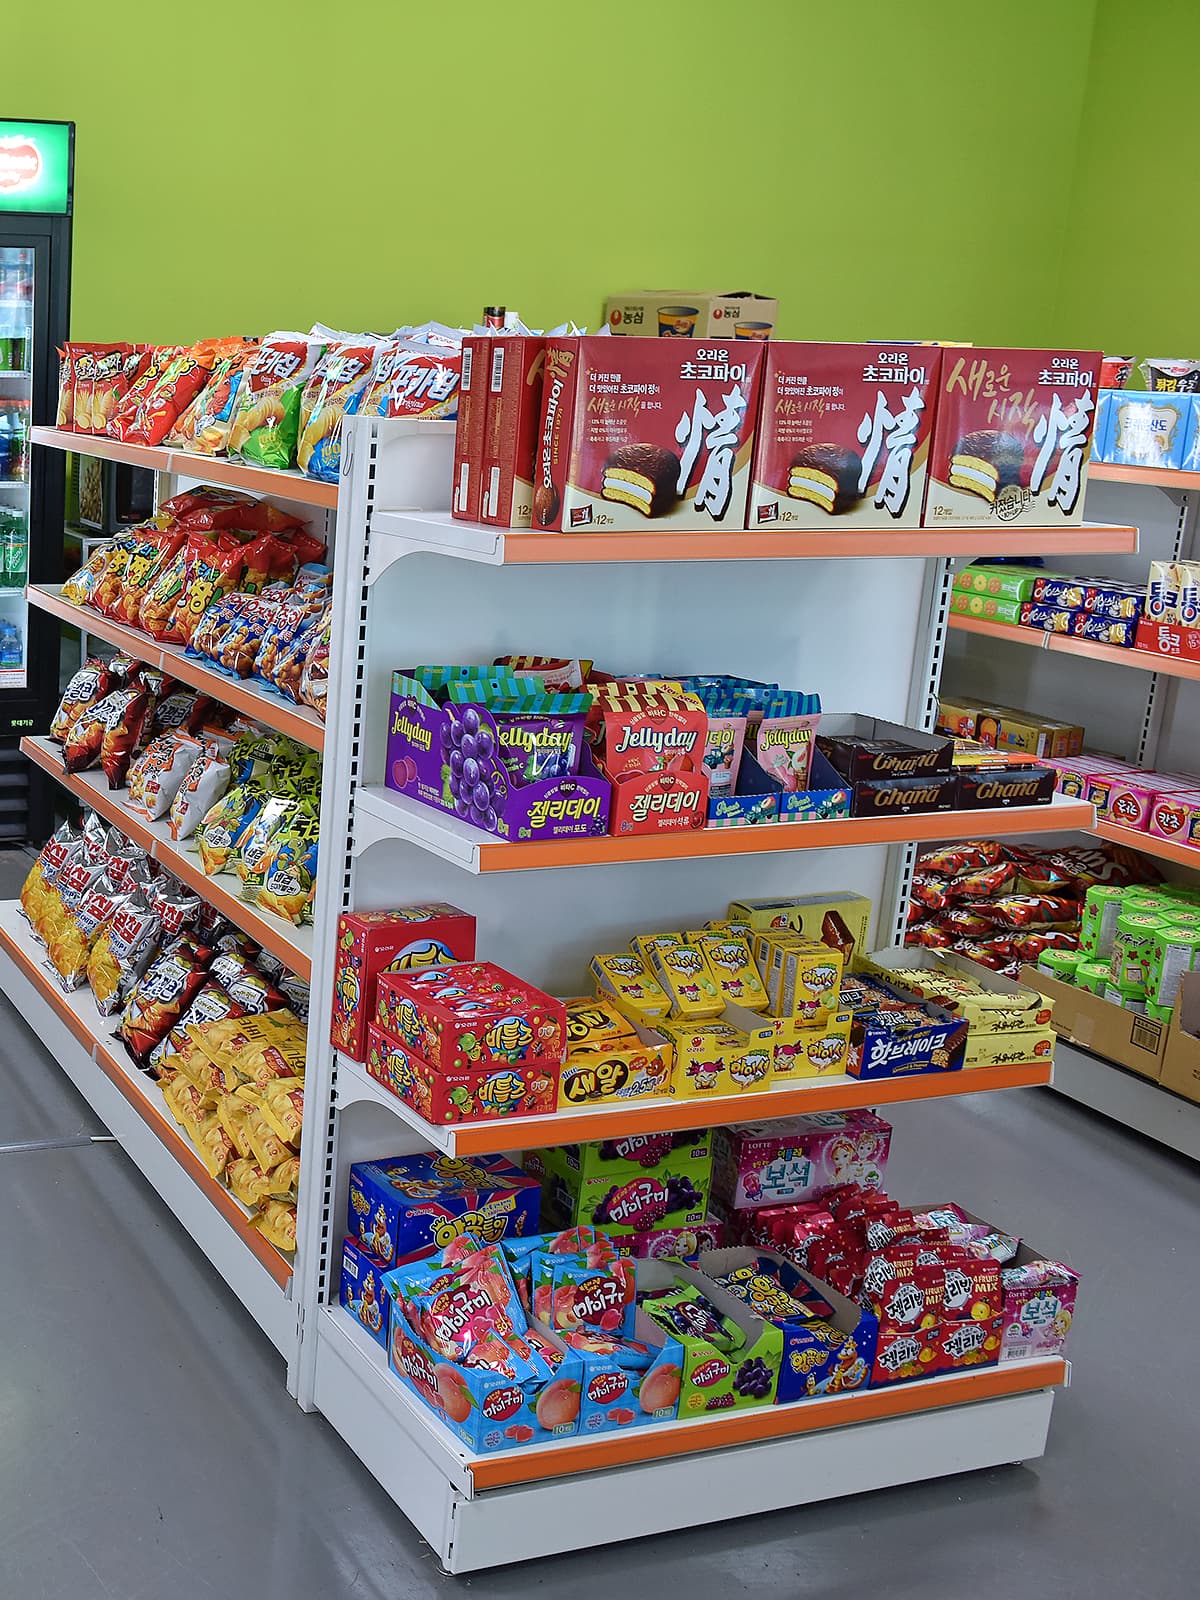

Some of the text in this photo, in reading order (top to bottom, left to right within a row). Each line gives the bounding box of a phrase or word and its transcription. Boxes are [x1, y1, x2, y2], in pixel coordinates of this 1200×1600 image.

[623, 312, 644, 324] 농심
[723, 308, 740, 319] 농심
[251, 347, 301, 379] 포카칩
[696, 348, 729, 363] 오리온
[877, 352, 909, 365] 오리온
[1051, 357, 1080, 371] 오리온
[390, 363, 460, 402] 포카칩
[680, 361, 747, 383] 초코파이
[863, 366, 926, 385] 초코파이
[946, 357, 1011, 397] 새로운
[1038, 370, 1094, 388] 초코파이
[988, 388, 1039, 440] 시작
[392, 711, 432, 752] Jellyday
[615, 726, 698, 753] Jellyday
[705, 729, 735, 748] 데이
[760, 728, 812, 752] Jellyday
[873, 753, 939, 772] Ghana
[874, 787, 940, 807] Ghana
[976, 781, 1039, 800] Ghana
[527, 796, 601, 829] 젤리데이
[629, 790, 700, 822] 젤리데이
[485, 1019, 534, 1050] 비틀즈
[478, 1074, 527, 1103] 비틀즈
[569, 1062, 624, 1100] 새알
[748, 1142, 771, 1150] LOTTE
[762, 1161, 812, 1190] 보석
[609, 1183, 669, 1222] 마이구미
[896, 1268, 914, 1277] MIX
[975, 1282, 998, 1293] MIX
[435, 1289, 492, 1343] 마이구미
[886, 1291, 925, 1318] 젤리밥
[1022, 1300, 1058, 1321] 보석
[878, 1342, 922, 1370] 젤리밥
[943, 1330, 987, 1356] 젤리밥
[401, 1353, 438, 1393] 마이구미
[692, 1362, 730, 1386] 마이구미
[588, 1375, 629, 1402] 마이구미
[482, 1390, 524, 1418] 마이구미
